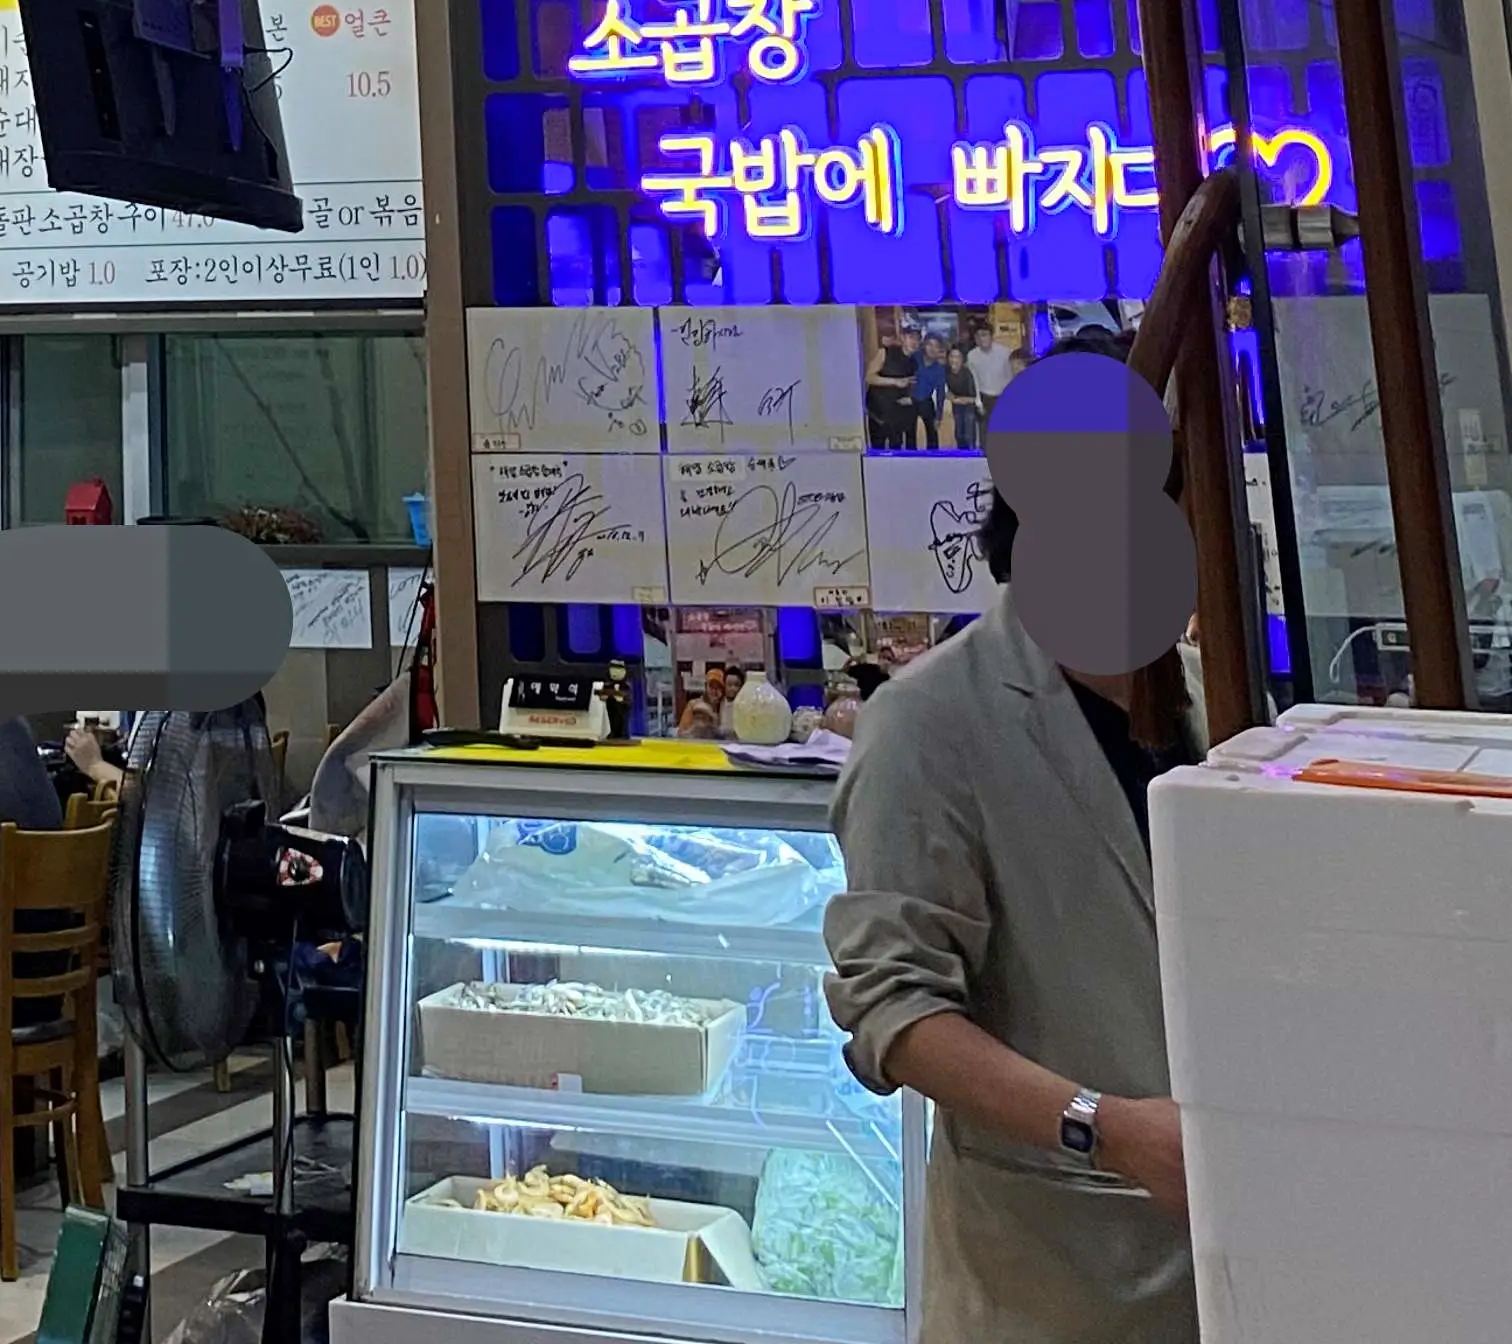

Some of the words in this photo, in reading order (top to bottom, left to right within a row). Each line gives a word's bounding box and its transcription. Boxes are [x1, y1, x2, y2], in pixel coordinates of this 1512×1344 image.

[313, 15, 337, 29] BEST
[344, 8, 392, 38] 얼큰
[347, 71, 392, 98] 10.5
[640, 125, 899, 238] 국밥에
[307, 197, 334, 229] 골
[12, 258, 81, 289] 공기밥
[88, 261, 116, 285] 1.0
